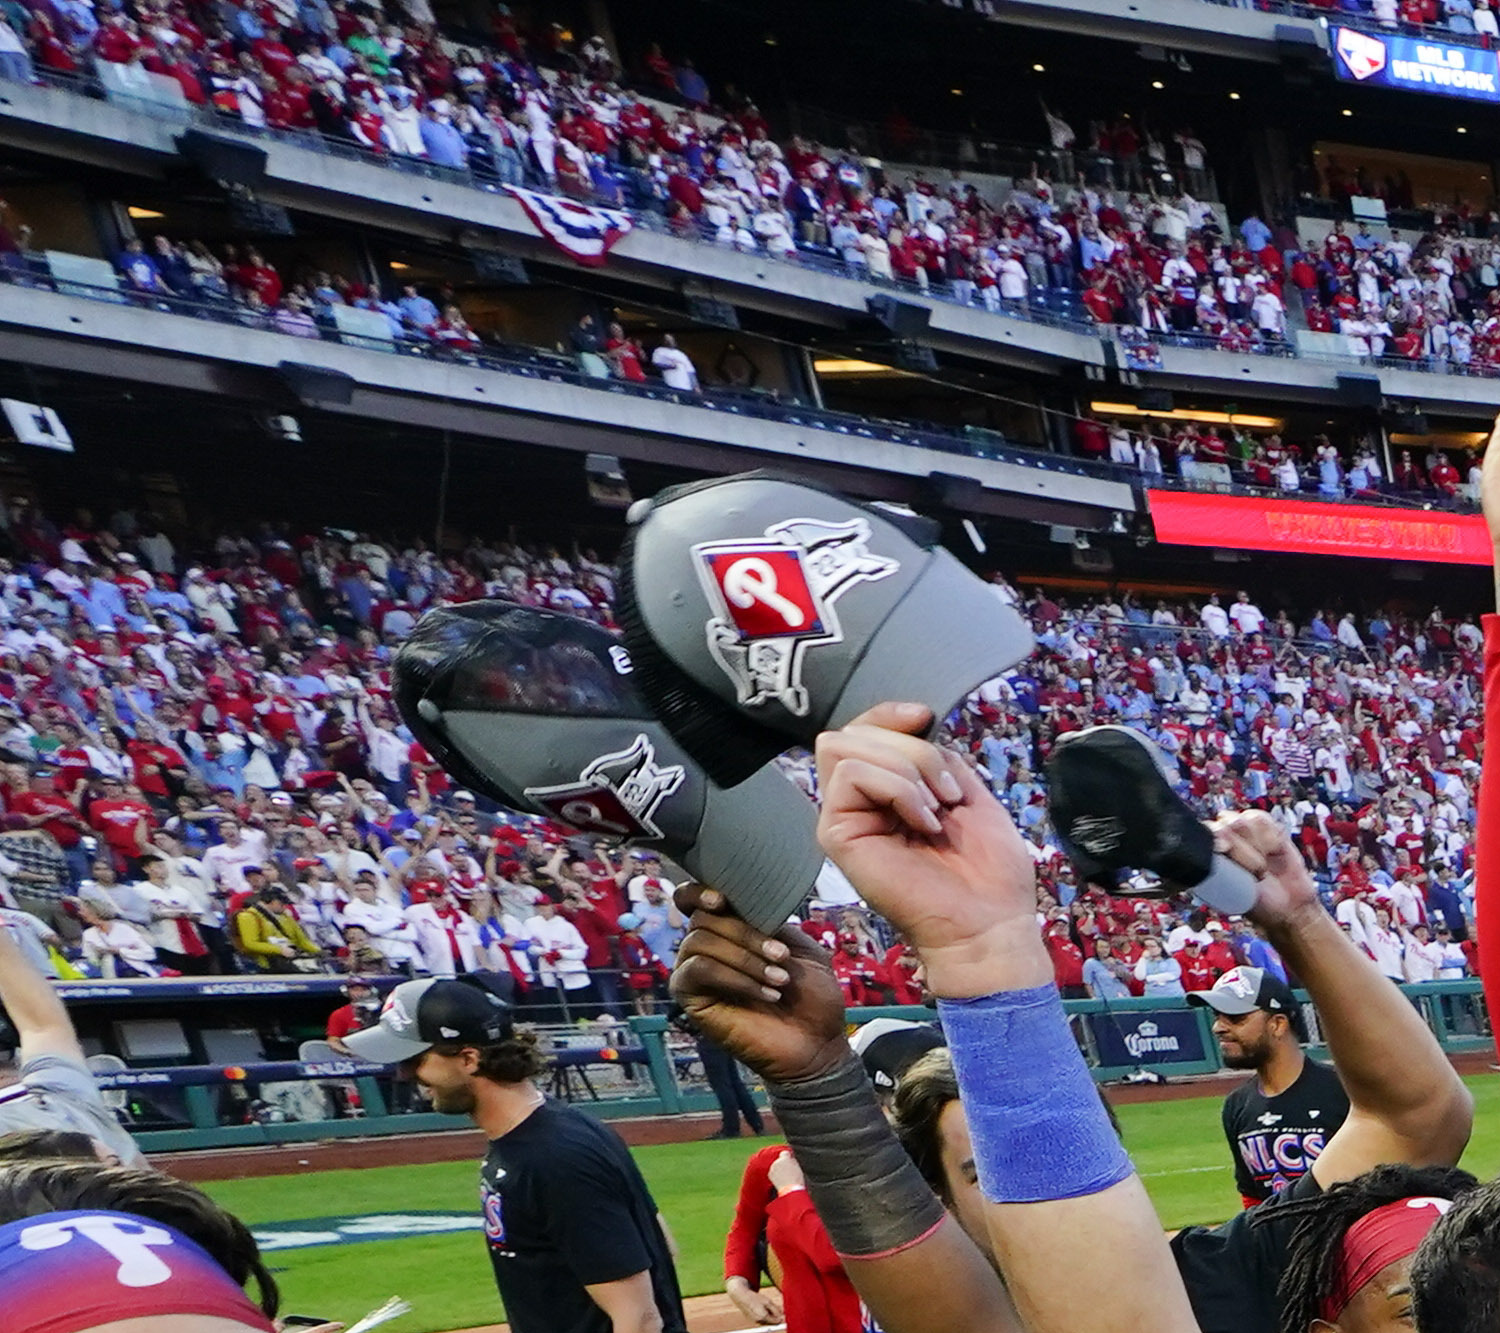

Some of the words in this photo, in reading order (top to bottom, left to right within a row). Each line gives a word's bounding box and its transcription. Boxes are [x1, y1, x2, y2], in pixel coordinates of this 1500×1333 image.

[1416, 46, 1465, 67] MLB
[1391, 60, 1496, 93] NETWORK
[1123, 1028, 1180, 1059] Corona
[1238, 1133, 1325, 1175] NLCS
